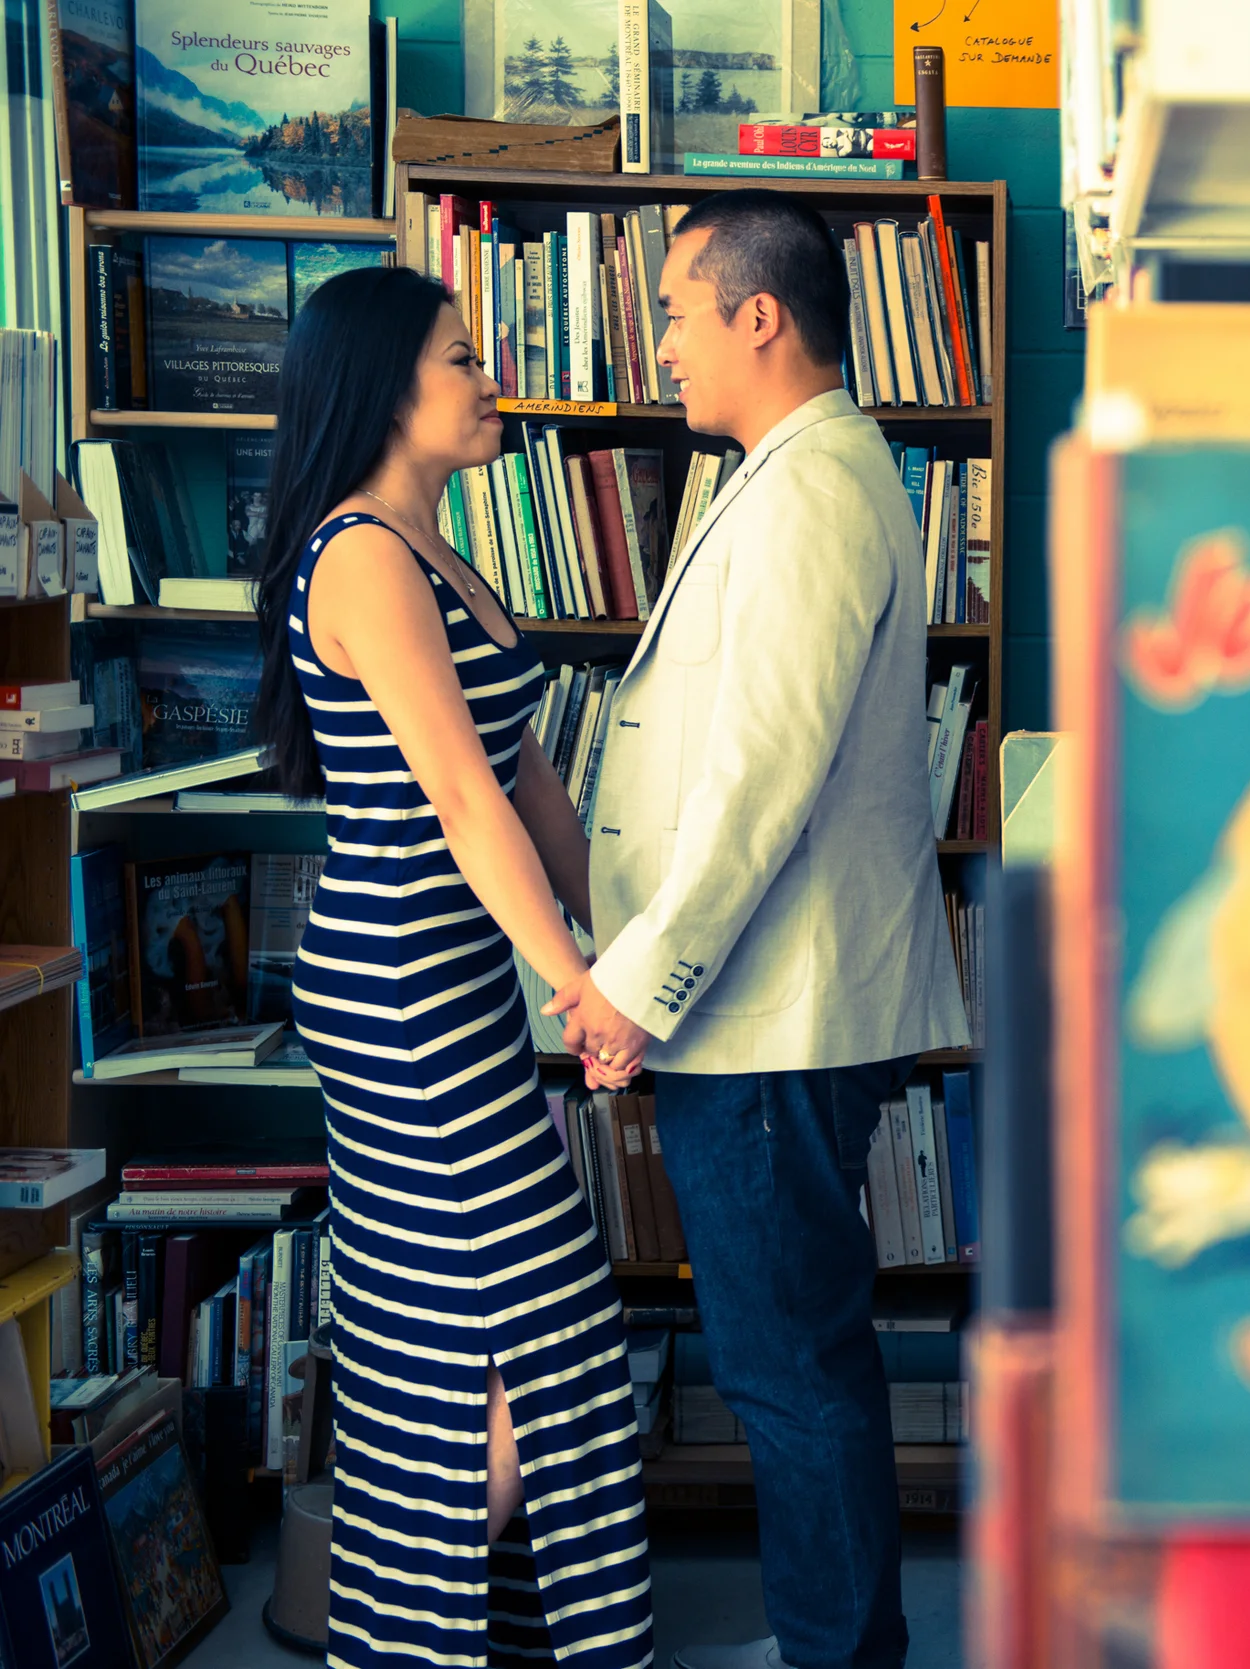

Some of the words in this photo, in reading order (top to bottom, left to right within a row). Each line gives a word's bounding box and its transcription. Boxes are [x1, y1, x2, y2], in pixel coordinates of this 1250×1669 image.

[68, 1, 129, 31] CHARLEVOI
[632, 5, 640, 16] LE
[171, 30, 269, 51] Splendeurs
[275, 41, 351, 60] sauvages
[624, 19, 633, 66] MONTRÉAL
[633, 23, 641, 56] GRAND
[965, 35, 1034, 47] CATALOGUE
[210, 59, 229, 72] du
[235, 53, 330, 78] Québec
[958, 52, 985, 63] SUR
[991, 51, 1052, 65] DEMANDE
[633, 62, 642, 111] SÉMINAIRE
[754, 136, 765, 153] Paul
[779, 127, 798, 154] LOUIS
[797, 131, 818, 152] CYR
[693, 159, 702, 167] La
[702, 160, 727, 169] grande
[761, 161, 776, 169] des
[776, 161, 804, 170] Indiens
[805, 162, 847, 173] d'Amérique
[847, 164, 858, 172] du
[859, 163, 876, 173] Nord
[849, 257, 859, 276] INUIT
[608, 265, 617, 298] SAUVAGES
[851, 278, 861, 300] DOLLS
[561, 302, 569, 332] QUÉBEC
[612, 315, 620, 331] CHEZ
[563, 335, 569, 344] LE
[163, 360, 209, 371] VILLAGES
[212, 361, 280, 374] PITTORESQUES
[514, 399, 605, 414] AMÉRINDIENS
[236, 448, 253, 457] UNE
[971, 464, 988, 488] Bic
[482, 491, 493, 537] Sainte-Séraphine
[960, 498, 967, 508] OF
[970, 495, 982, 529] 150e
[455, 511, 463, 536] ÉLECTRIQUE
[959, 513, 967, 556] TADOUSSAC
[488, 538, 494, 546] de
[490, 547, 498, 570] paroisse
[153, 703, 249, 726] GASPÉSIE
[938, 727, 951, 753] l'hiver
[932, 752, 946, 779] C'était
[144, 875, 161, 889] Les
[164, 870, 206, 887] animaux
[208, 864, 248, 880] littoraux
[158, 888, 171, 901] du
[173, 879, 236, 899] Saint-Laurent
[921, 1177, 931, 1218] RELATIONS
[166, 1207, 176, 1215] de
[199, 1208, 228, 1216] histoire
[87, 1262, 98, 1284] LES
[87, 1289, 98, 1321] ARTS
[126, 1270, 138, 1328] BEAULIEU
[278, 1281, 287, 1331] MASTERPIECES
[87, 1327, 101, 1372] SACRÉS
[906, 1492, 932, 1504] 1914
[2, 1485, 91, 1569] MONTRÉAL
